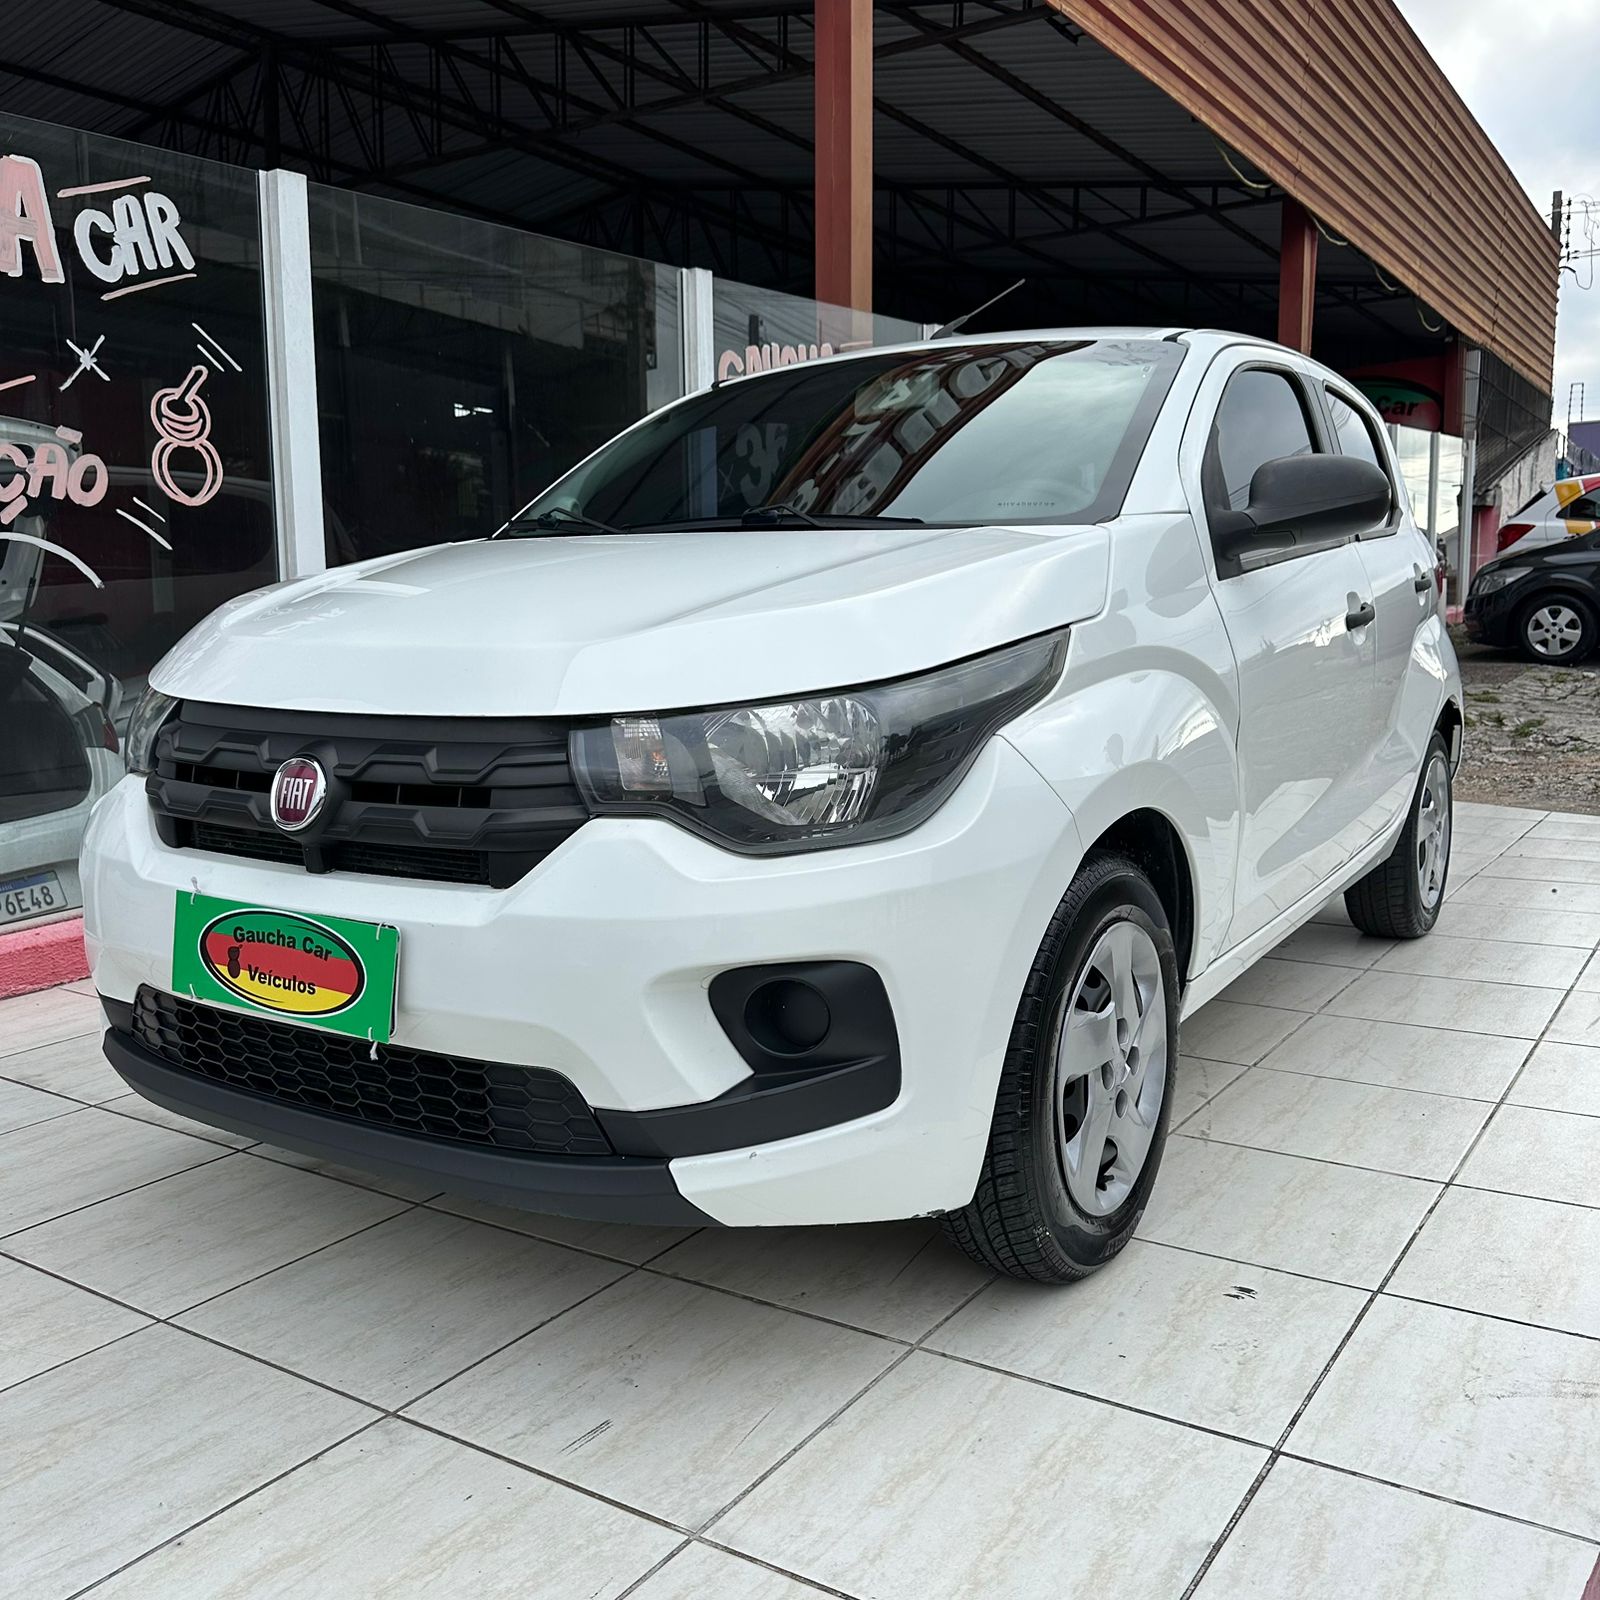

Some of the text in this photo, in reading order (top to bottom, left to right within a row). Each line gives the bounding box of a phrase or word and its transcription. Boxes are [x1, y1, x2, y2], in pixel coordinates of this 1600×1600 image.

[74, 192, 195, 282] CAR
[280, 777, 314, 810] FIAT
[233, 926, 332, 961] Gaucha Car
[248, 963, 316, 995] Veículos
